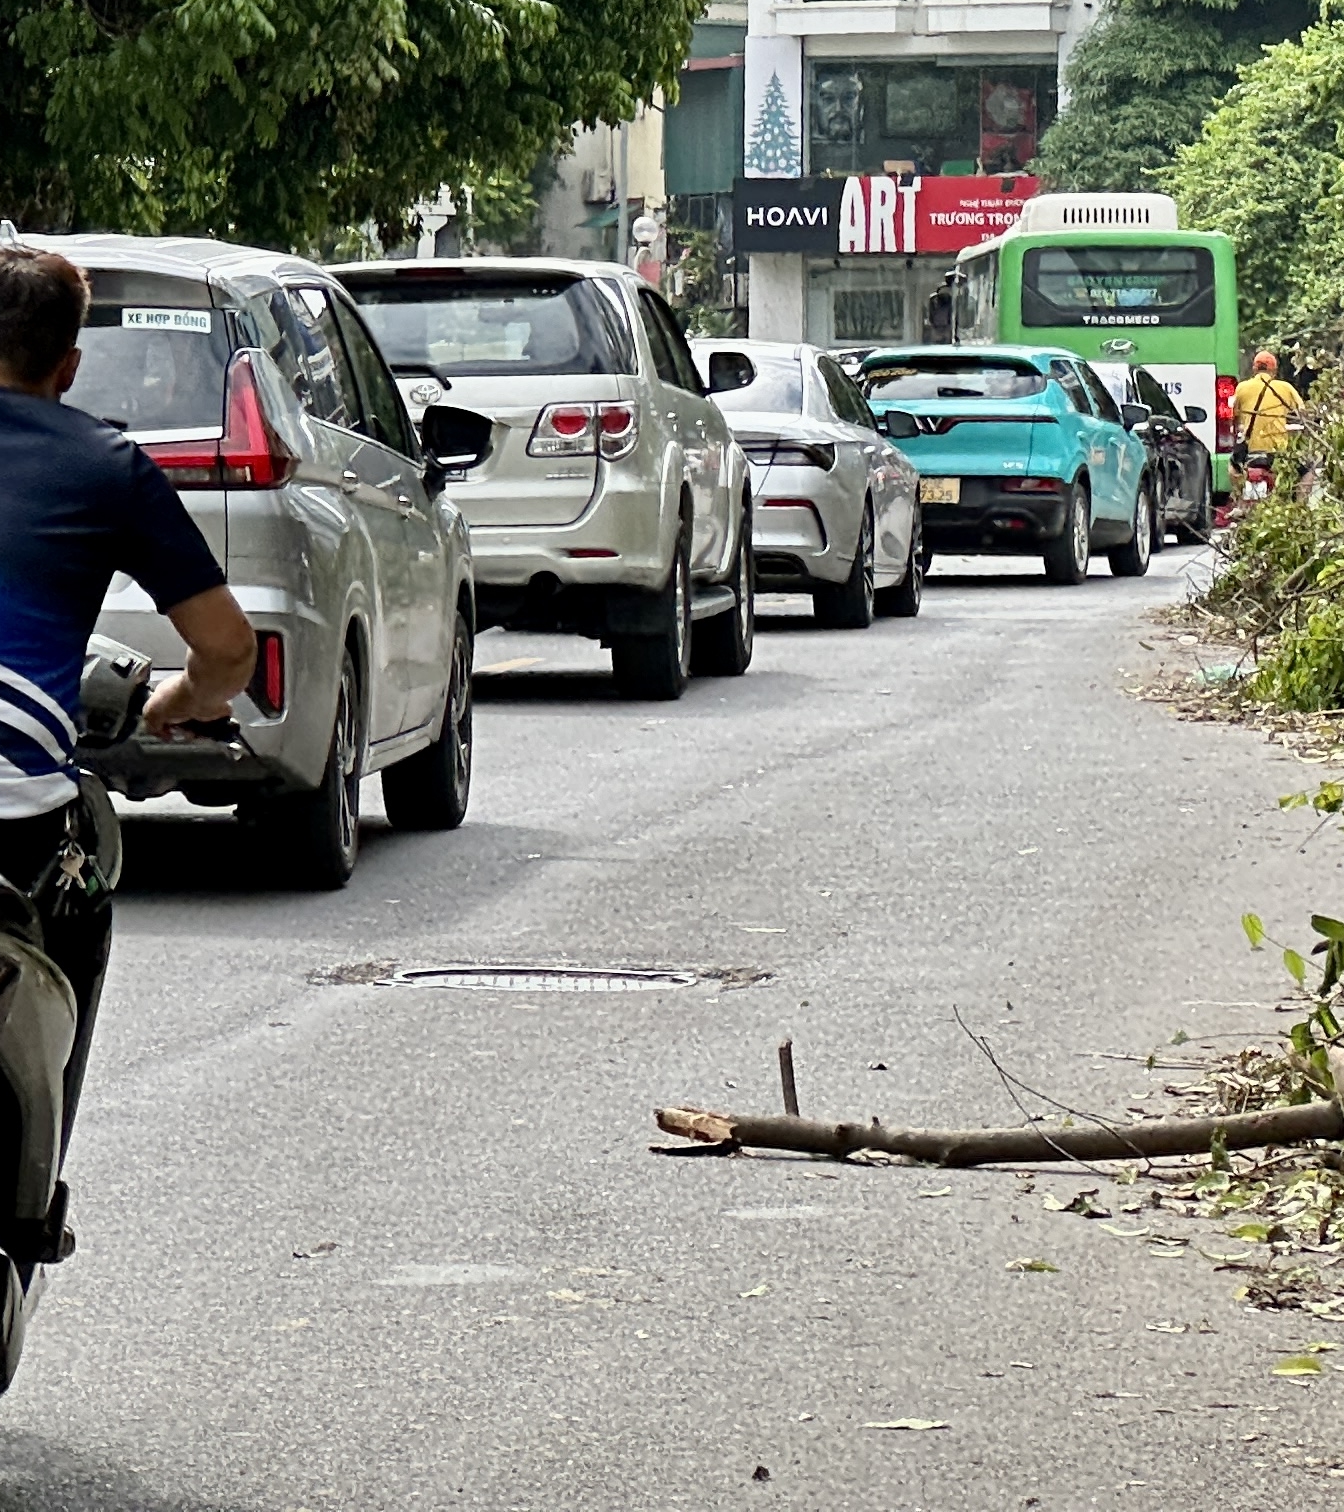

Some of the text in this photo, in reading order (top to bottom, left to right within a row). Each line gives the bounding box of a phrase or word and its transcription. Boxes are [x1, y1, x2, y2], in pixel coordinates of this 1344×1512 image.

[839, 176, 922, 253] ART
[127, 313, 143, 324] XE
[146, 313, 170, 326] HỢP
